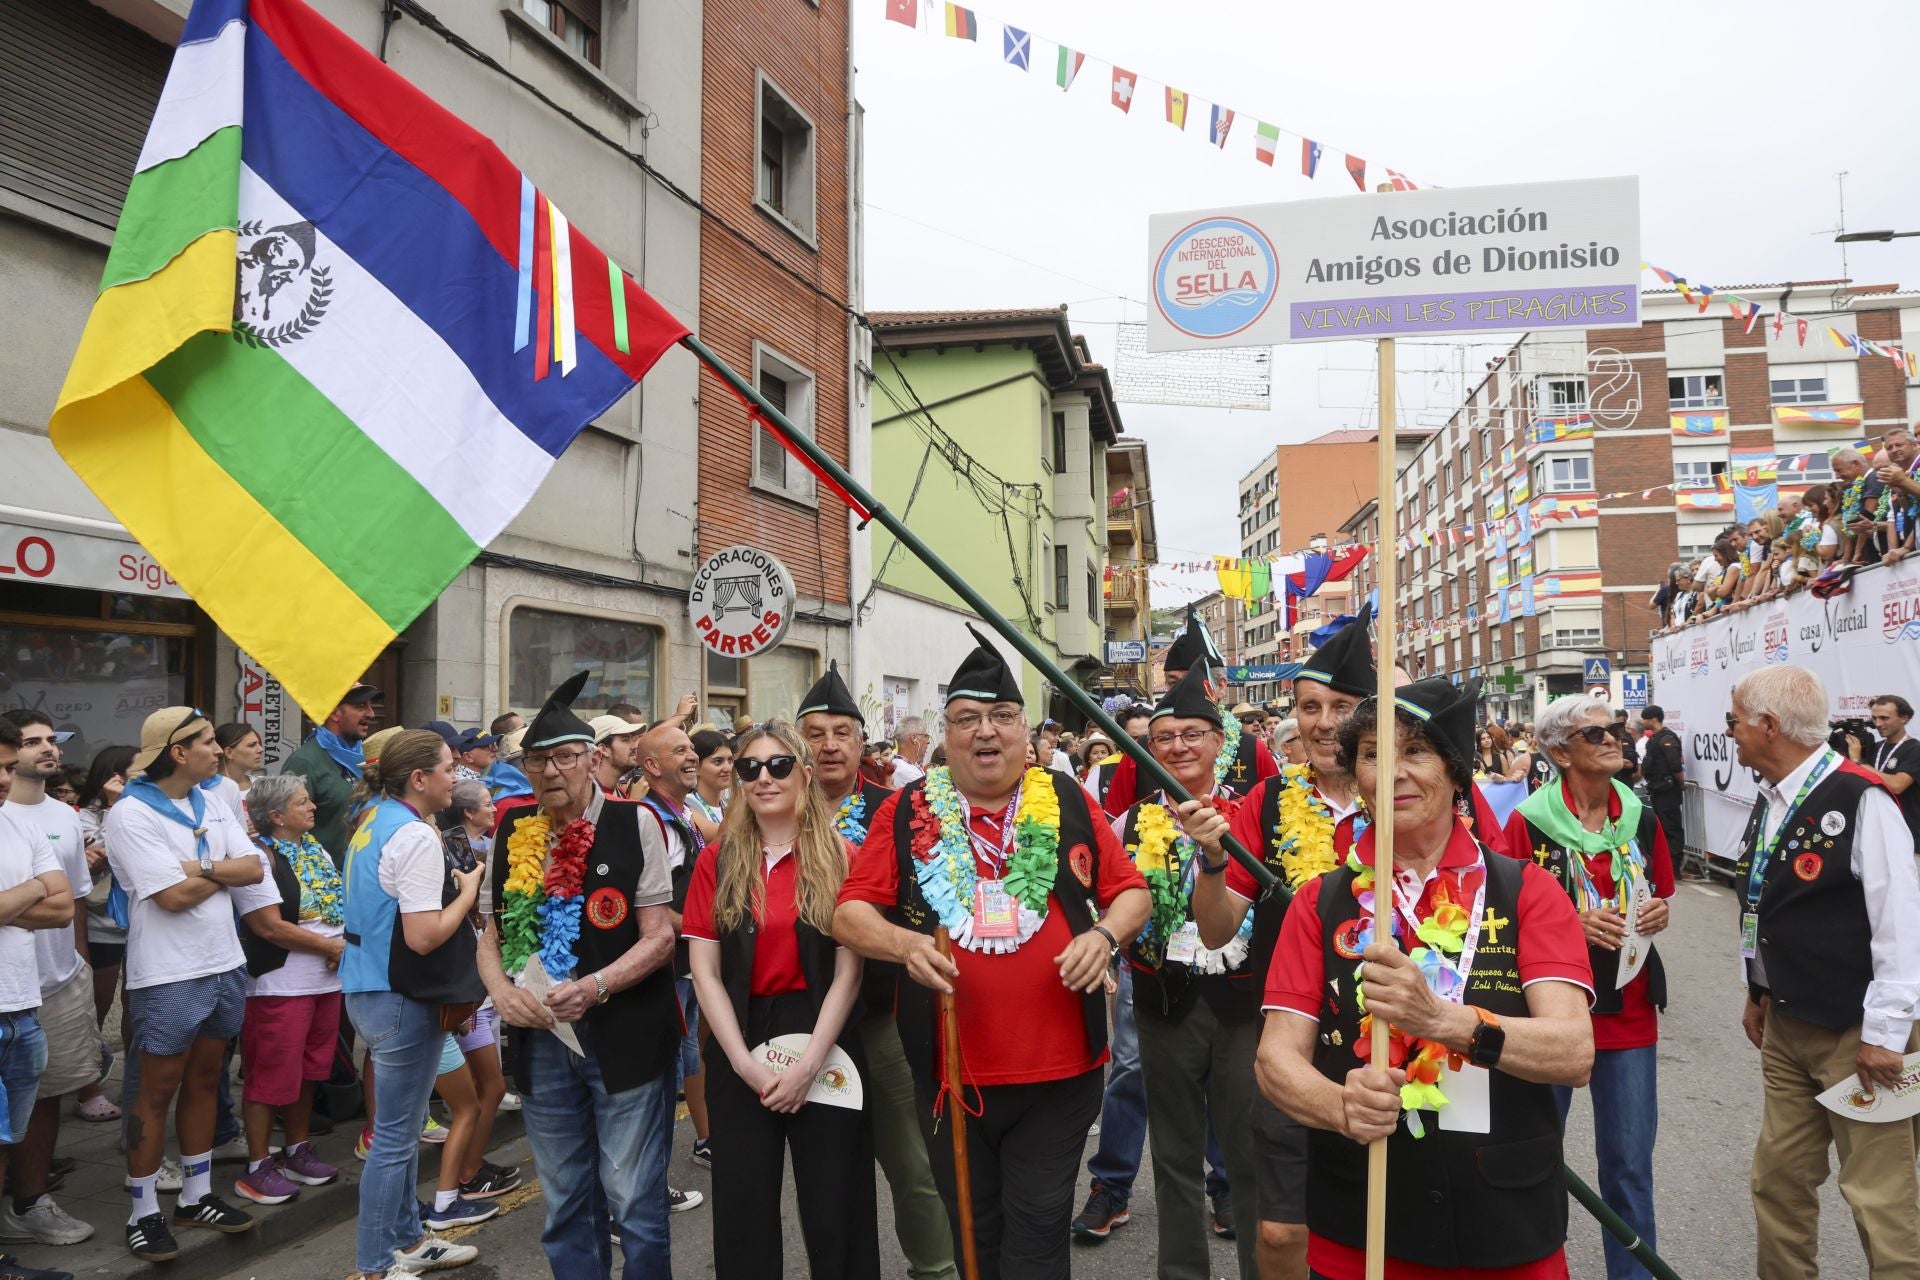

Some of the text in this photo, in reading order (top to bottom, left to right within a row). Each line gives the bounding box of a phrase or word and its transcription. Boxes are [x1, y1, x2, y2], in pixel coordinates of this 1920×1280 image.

[1371, 207, 1547, 241] Asociación
[1178, 245, 1256, 262] INTERNACIONAL
[1191, 235, 1243, 250] DESCENSO
[1207, 259, 1227, 271] DEL
[1305, 241, 1620, 285] Amigos de Dionisio
[1176, 270, 1258, 296] SELLA
[1299, 291, 1628, 329] VIVAN LES PIRAGÜES
[691, 549, 783, 602] DECORACIONES
[695, 610, 782, 655] PARRES
[1800, 624, 1821, 641] casa
[1812, 600, 1868, 653] Marcial
[1764, 627, 1789, 651] SELLA
[1691, 649, 1709, 667] SELLA
[1249, 671, 1276, 680] Unicaja
[1626, 674, 1643, 690] T
[440, 698, 450, 714] 5
[1624, 690, 1646, 698] TAXI
[1693, 733, 1728, 762] casa
